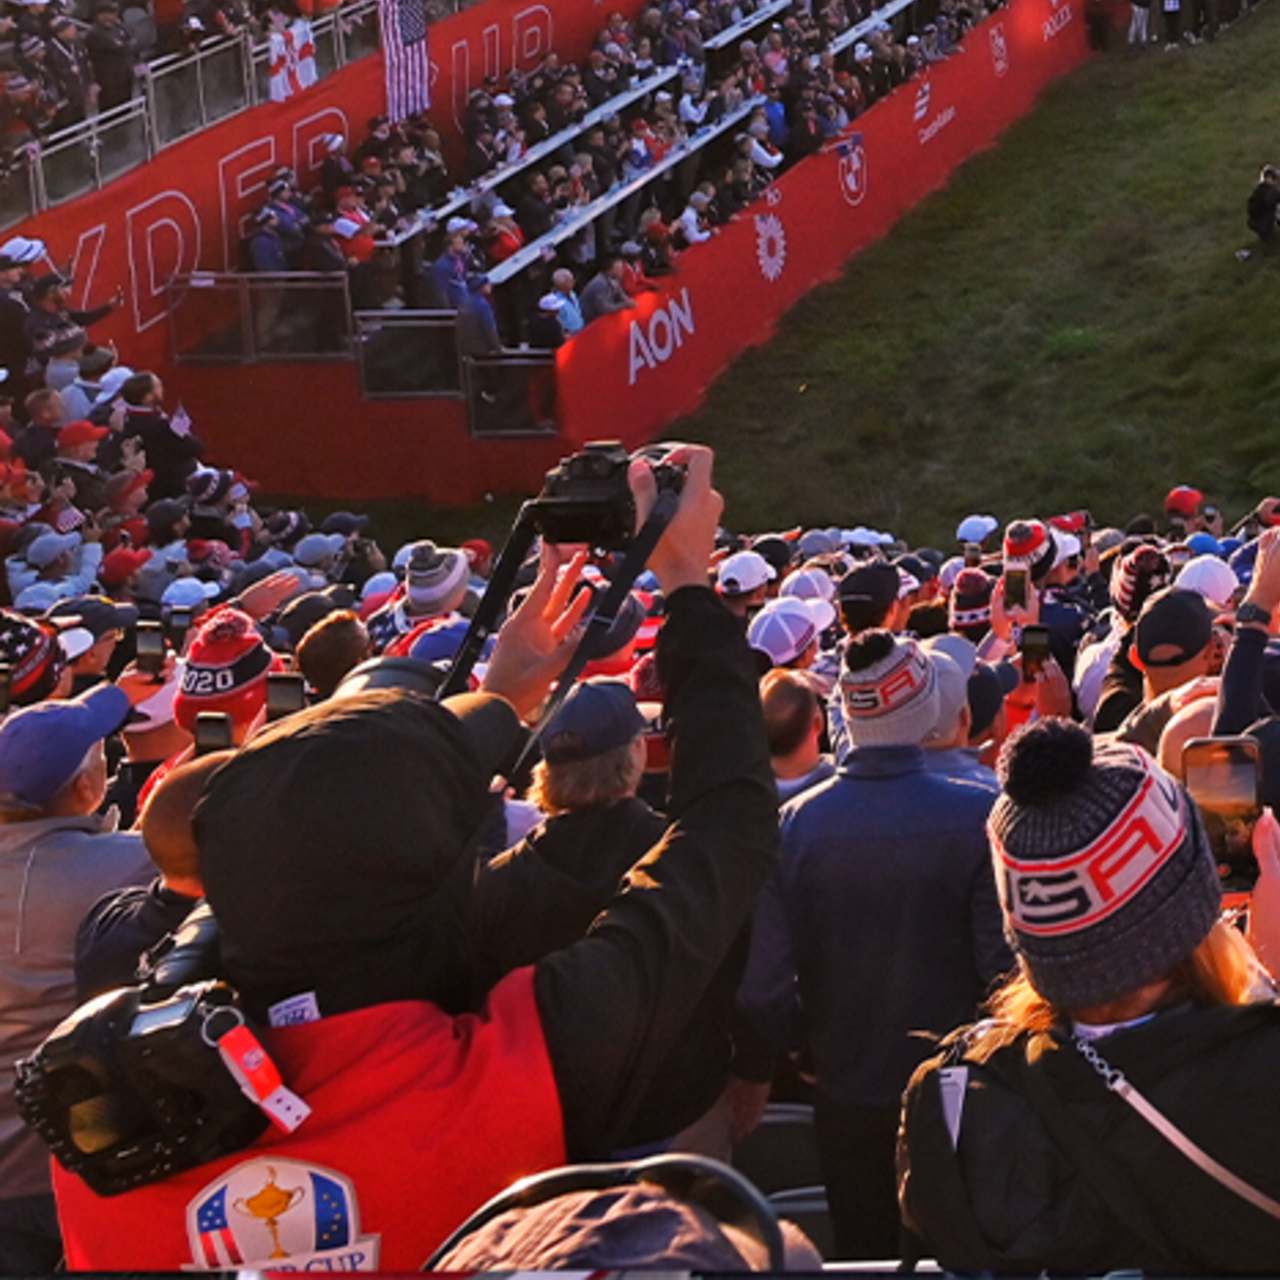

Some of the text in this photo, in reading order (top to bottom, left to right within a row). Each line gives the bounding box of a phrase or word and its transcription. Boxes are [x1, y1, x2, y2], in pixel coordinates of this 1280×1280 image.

[629, 287, 695, 386] AON
[183, 669, 235, 693] 020
[847, 668, 916, 711] SA
[1007, 816, 1166, 924] SA
